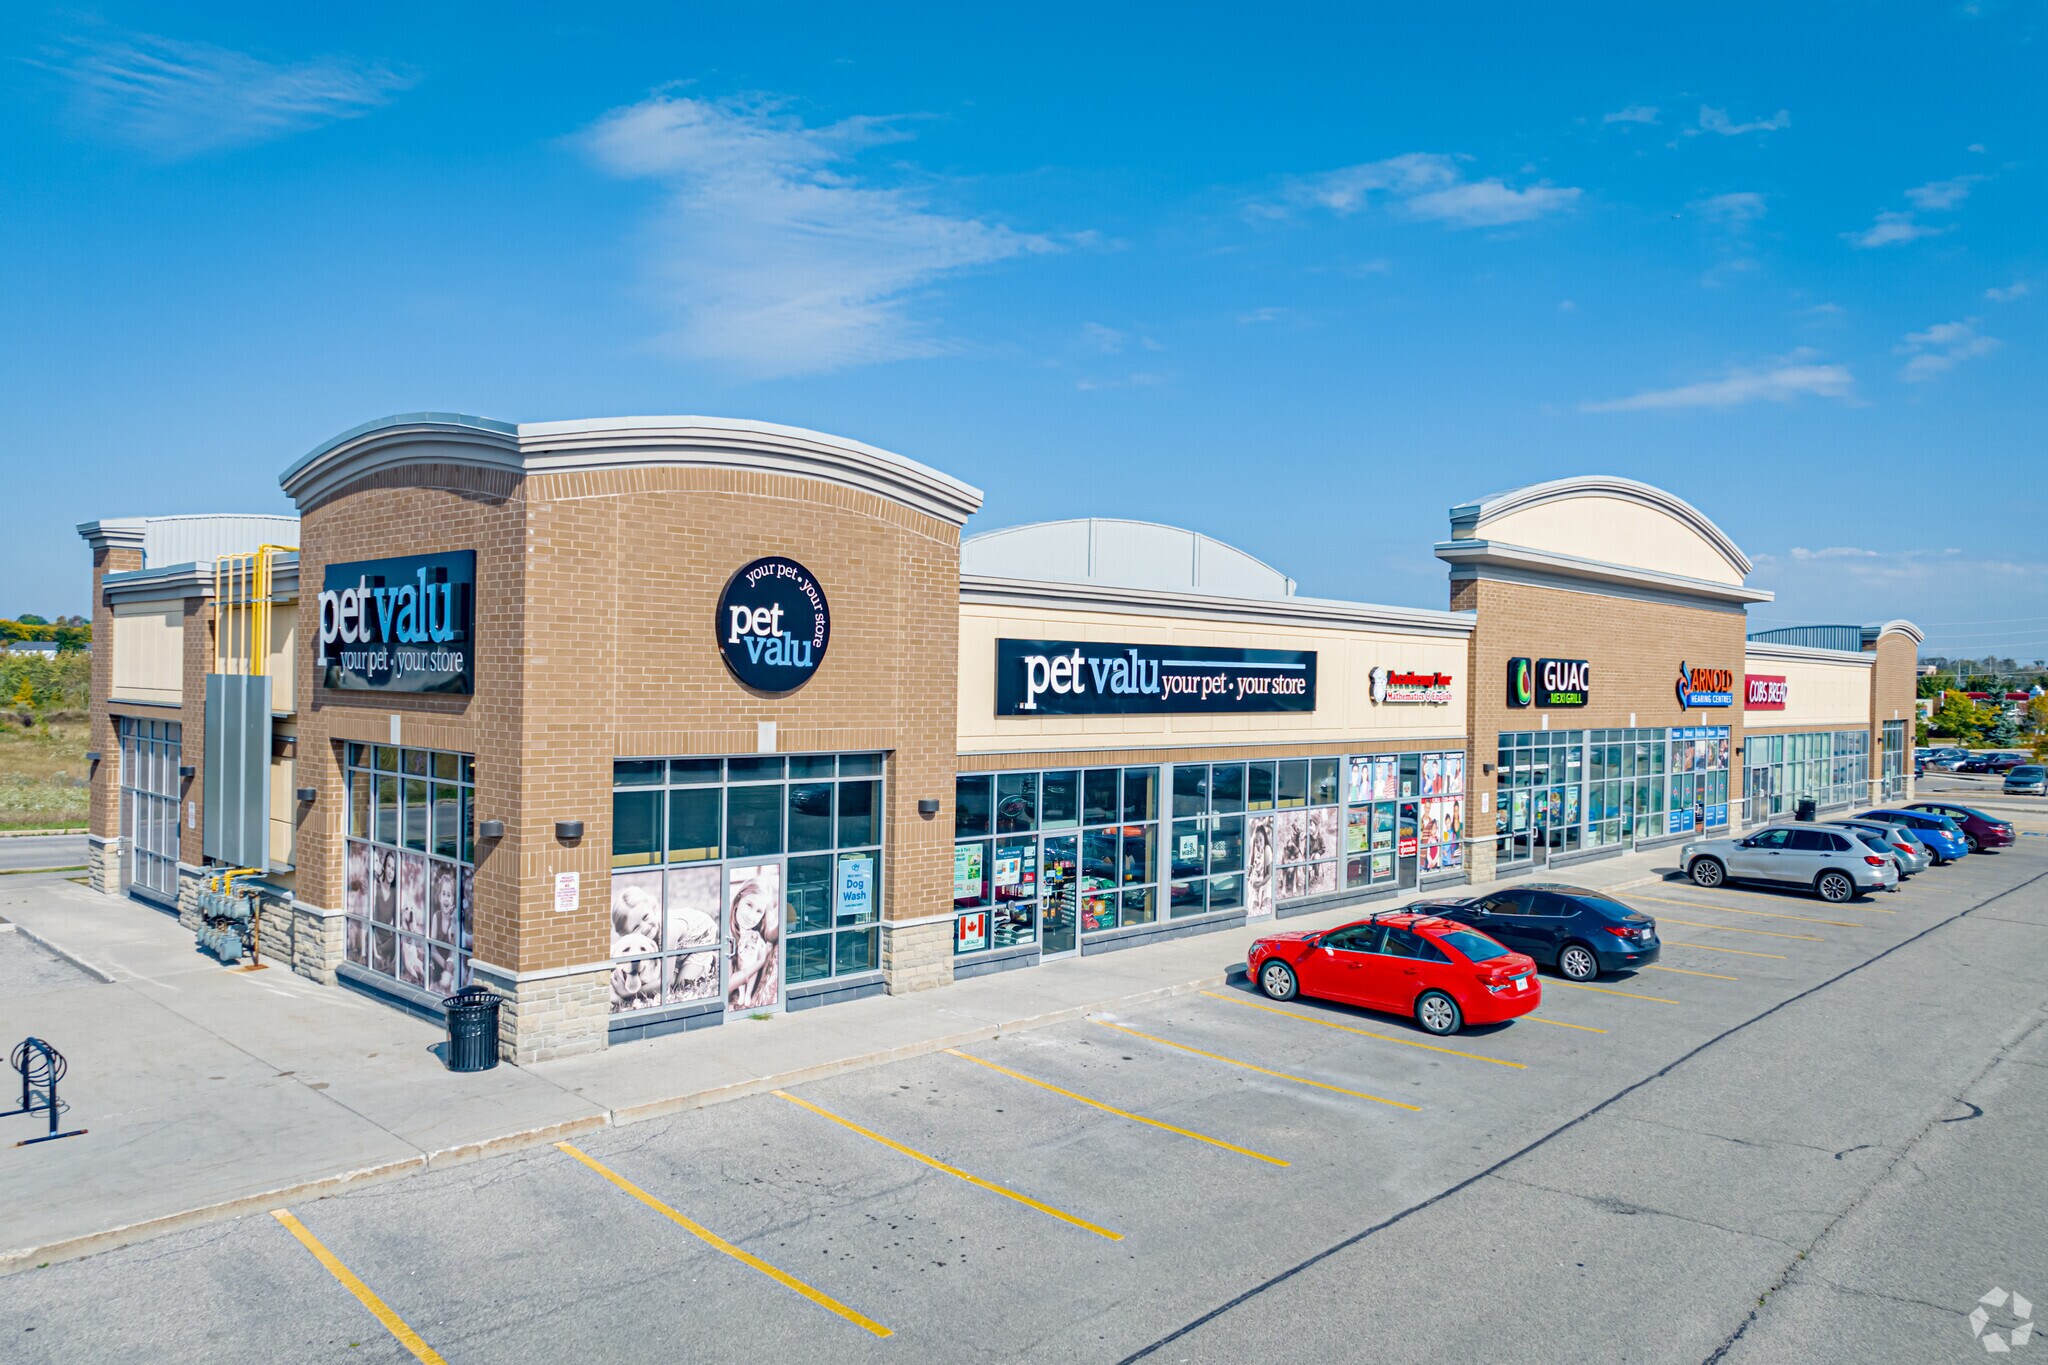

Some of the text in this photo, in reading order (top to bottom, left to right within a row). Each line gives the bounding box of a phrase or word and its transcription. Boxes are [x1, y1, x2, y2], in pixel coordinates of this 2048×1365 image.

[317, 566, 455, 666] pet valu
[745, 563, 826, 648] your pet your store
[728, 602, 785, 644] pet
[743, 631, 813, 668] valu
[340, 649, 464, 679] your pet your store
[1543, 660, 1590, 692] GUAC
[1024, 648, 1306, 710] pet valu your pet your store
[1690, 668, 1734, 692] ARNOLD
[1748, 680, 1788, 703] COBS BREAD
[1387, 692, 1424, 700] Mathematics
[1432, 692, 1452, 703] English
[1550, 692, 1583, 704] MEXI GRILL
[1691, 694, 1732, 704] HEARING CENTRES
[843, 891, 866, 900] Wash
[847, 880, 864, 890] Dog
